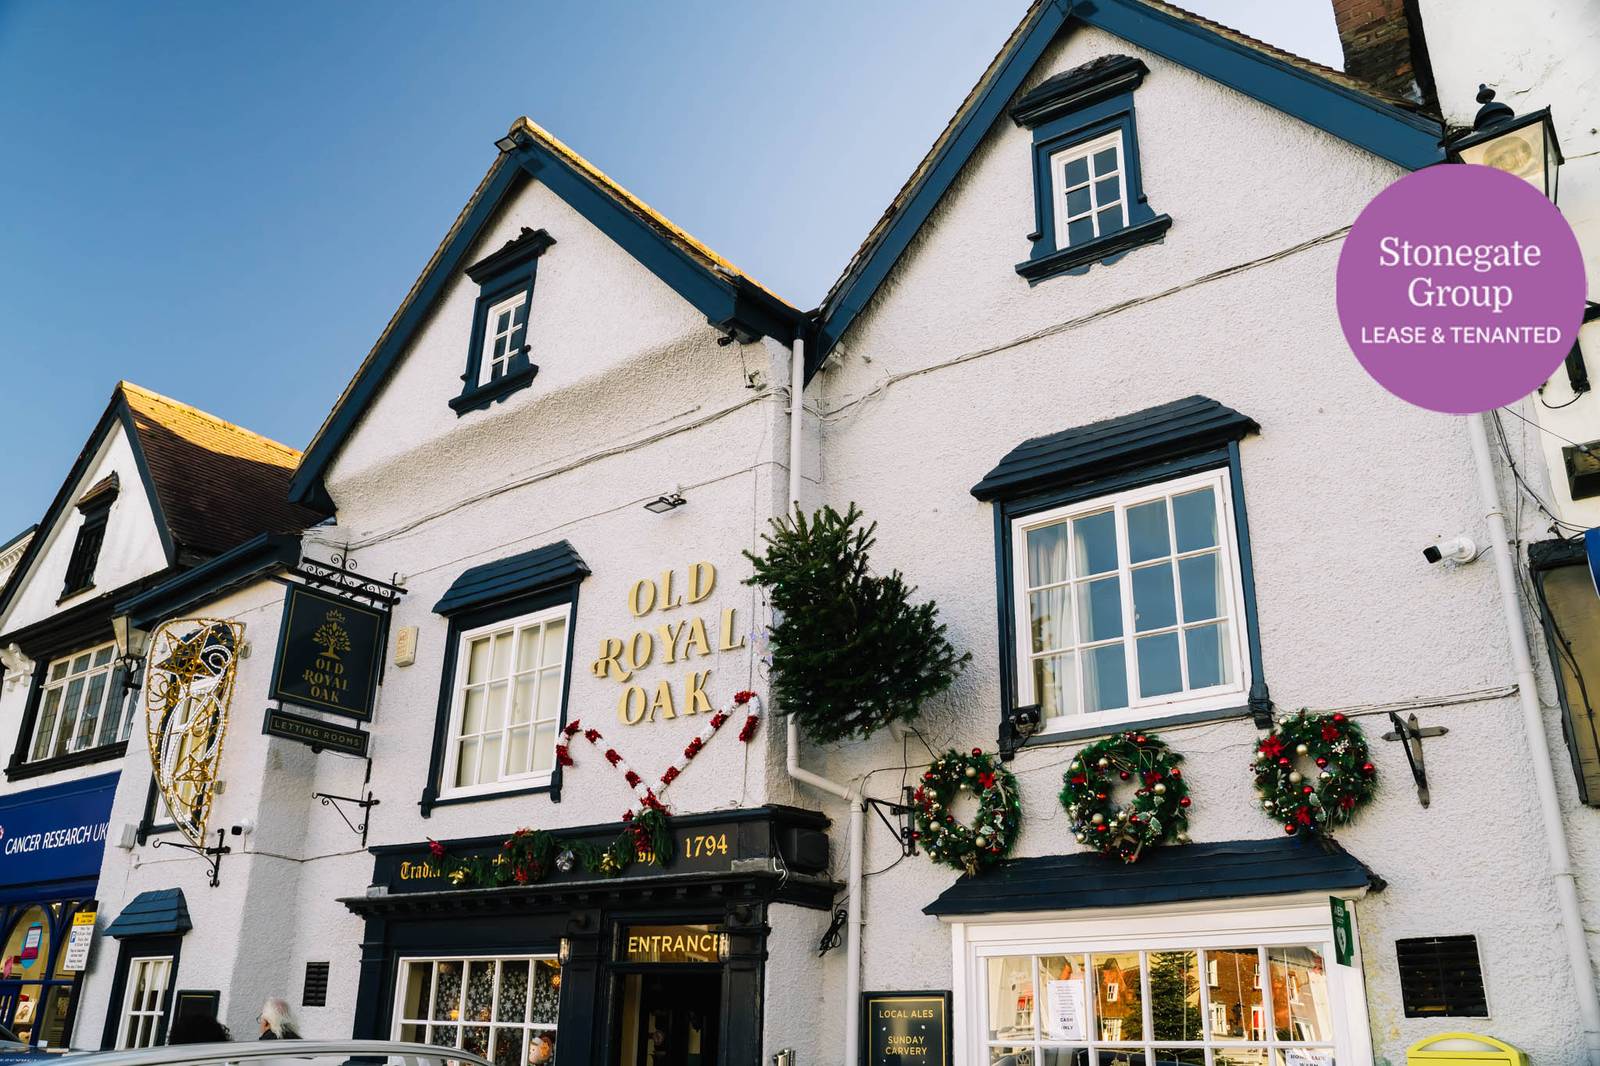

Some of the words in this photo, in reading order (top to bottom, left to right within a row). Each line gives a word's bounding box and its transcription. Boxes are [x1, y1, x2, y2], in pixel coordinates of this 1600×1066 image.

[628, 560, 717, 617] OLD
[590, 608, 745, 682] ROYAL
[315, 658, 344, 675] OLD
[302, 668, 349, 691] ROYAL
[310, 685, 340, 703] OAK
[617, 669, 714, 725] OAK
[274, 720, 320, 737] LETTING
[324, 731, 360, 746] ROOMS
[5, 833, 42, 855] CANCER
[42, 824, 93, 849] RESEARCH
[93, 822, 109, 842] UK
[685, 833, 728, 858] 1794
[879, 1009, 908, 1018] LOCAL
[911, 1009, 934, 1018] ALES
[885, 1046, 928, 1055] CARVERY
[888, 1035, 925, 1045] SUNDAY
